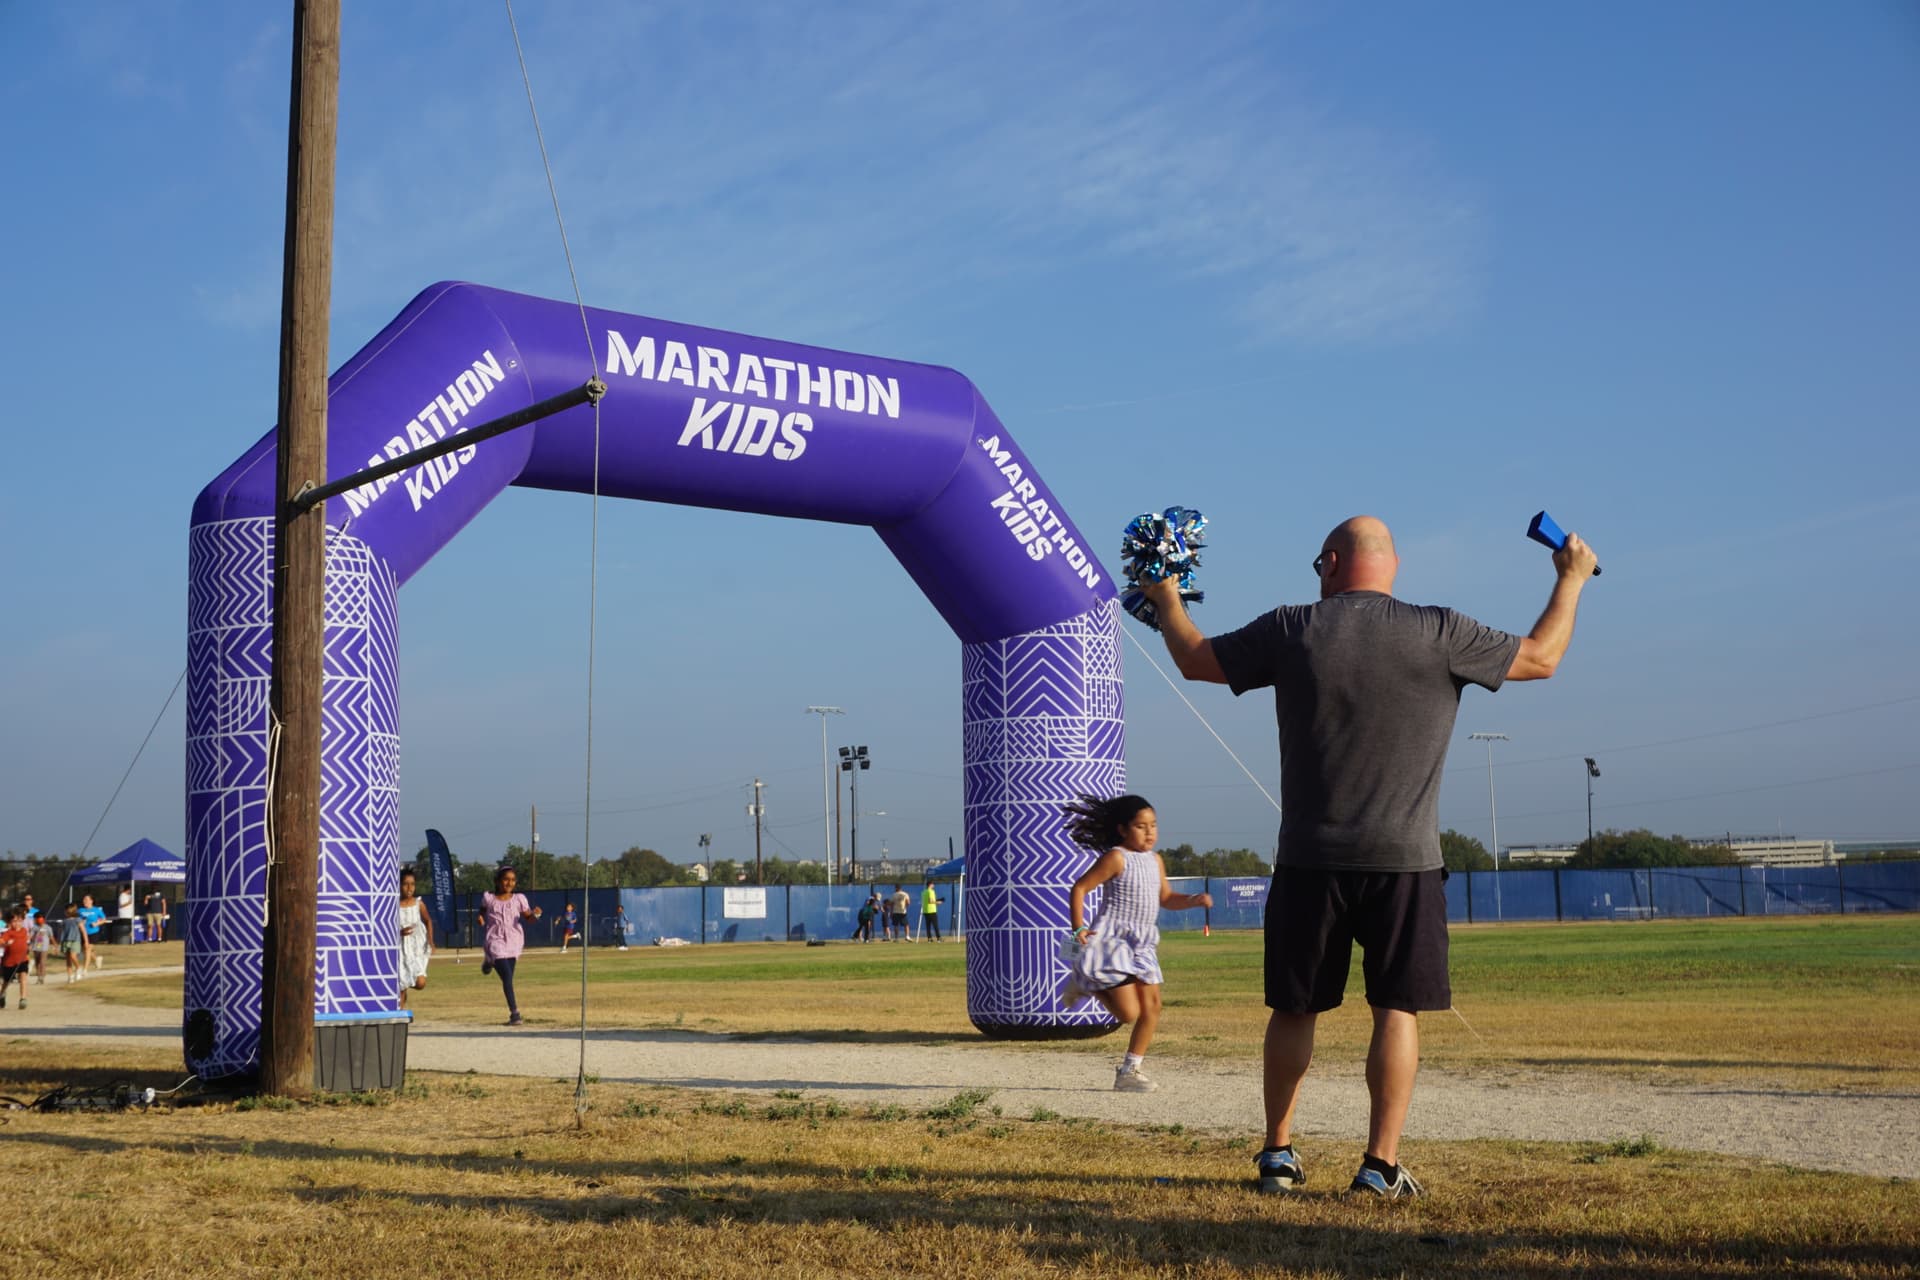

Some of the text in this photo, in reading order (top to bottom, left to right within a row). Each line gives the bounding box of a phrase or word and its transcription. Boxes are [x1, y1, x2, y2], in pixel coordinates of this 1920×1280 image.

[606, 330, 900, 418] MARATHON
[677, 398, 813, 461] KIDS
[982, 435, 1100, 588] MARATHON
[990, 490, 1053, 560] KIDS
